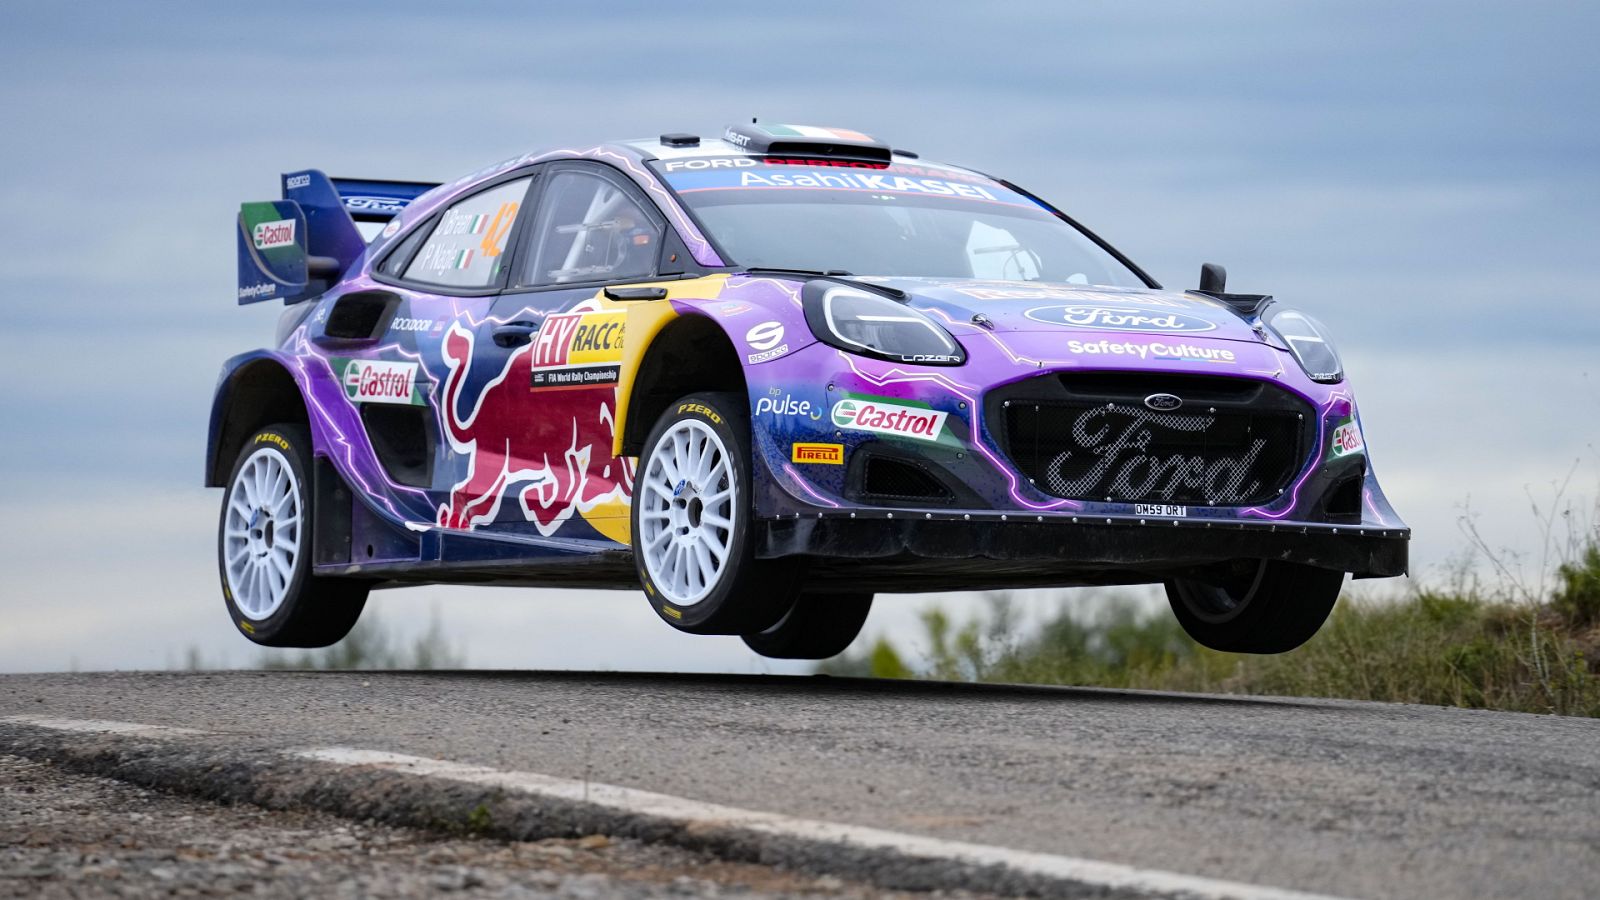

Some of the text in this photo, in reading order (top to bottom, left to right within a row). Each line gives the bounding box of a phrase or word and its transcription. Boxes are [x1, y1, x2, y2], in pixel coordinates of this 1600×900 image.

[665, 158, 758, 172] FORD
[287, 175, 310, 188] sparco
[263, 223, 292, 246] Castrol
[480, 203, 519, 257] 42
[420, 243, 436, 271] P
[238, 283, 276, 298] SafetyCulture
[391, 317, 432, 331] ROCKDOOR
[1064, 306, 1184, 328] Ford
[535, 317, 578, 365] HY
[572, 322, 619, 352] RACC
[1067, 340, 1236, 360] SafetyCulture
[750, 346, 787, 362] sparco
[360, 365, 412, 398] Castrol
[548, 373, 557, 383] FIA
[557, 371, 571, 382] World
[571, 371, 584, 383] Rally
[584, 369, 617, 382] Championship
[769, 386, 781, 397] bp
[756, 394, 811, 416] pulse
[1153, 395, 1175, 407] Ford
[855, 405, 939, 436] Castrol
[796, 446, 839, 461] PIRELLI
[1049, 405, 1267, 504] Ford
[1136, 504, 1184, 516] OM59 ORT
